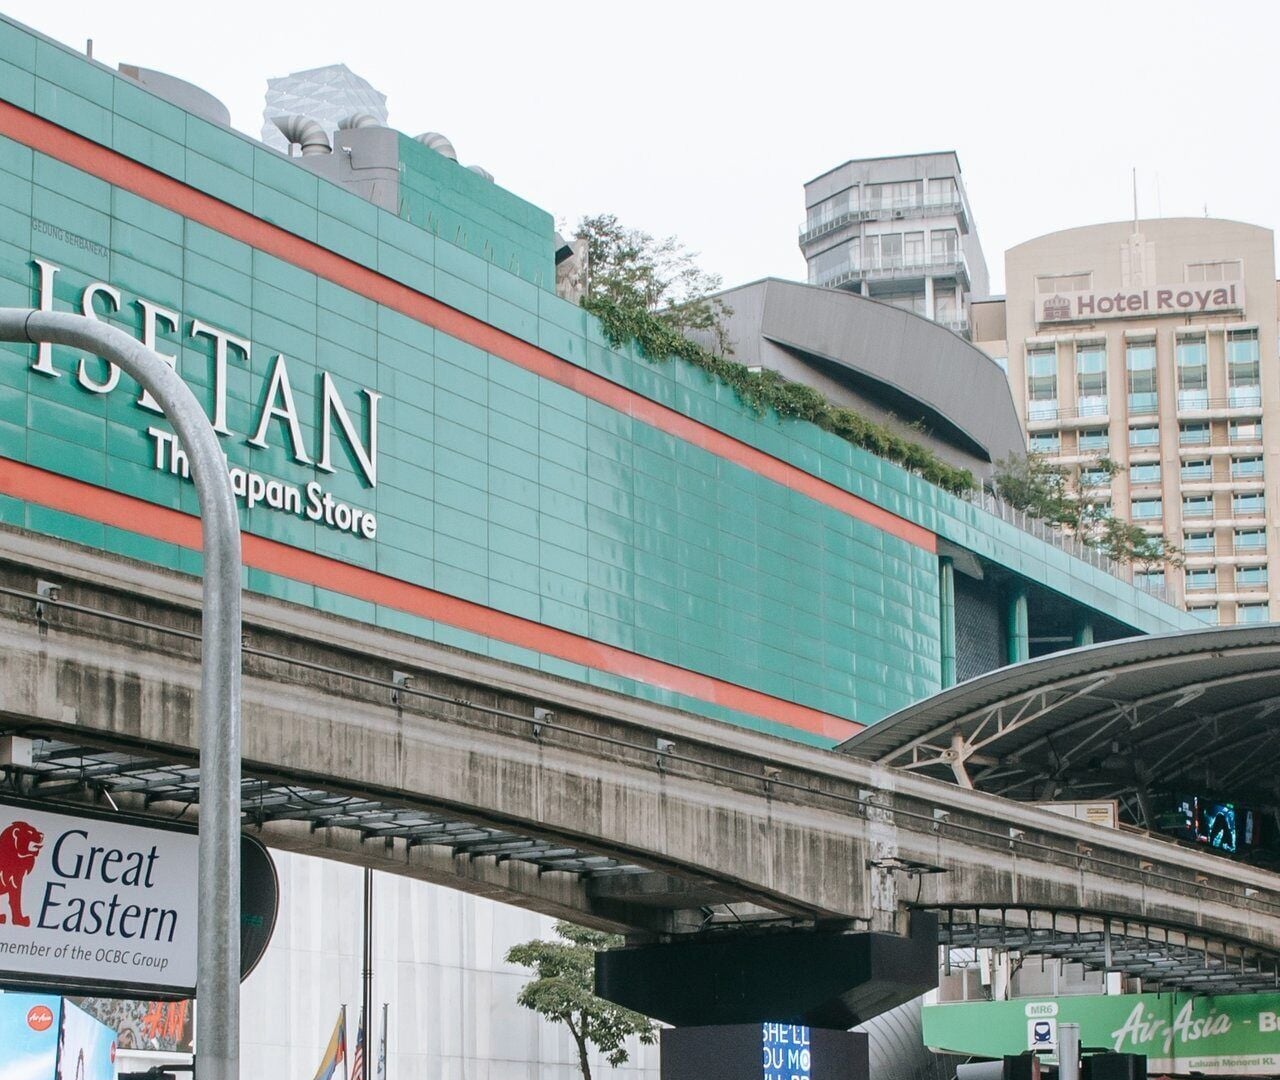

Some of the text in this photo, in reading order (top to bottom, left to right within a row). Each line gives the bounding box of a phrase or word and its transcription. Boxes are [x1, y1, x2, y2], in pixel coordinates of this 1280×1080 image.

[32, 218, 63, 241] GEDUNG
[1077, 284, 1236, 315] Hotel Royal
[29, 257, 383, 489] ISETAN
[147, 426, 378, 540] Th apan Store
[51, 828, 160, 888] Great
[36, 881, 179, 943] Eastern
[54, 944, 70, 960] of
[71, 944, 92, 961] the
[95, 948, 130, 964] OCBC
[132, 951, 169, 972] Group
[1030, 1004, 1054, 1015] MR6
[1188, 1057, 1276, 1069] Laluan Monorel KL
